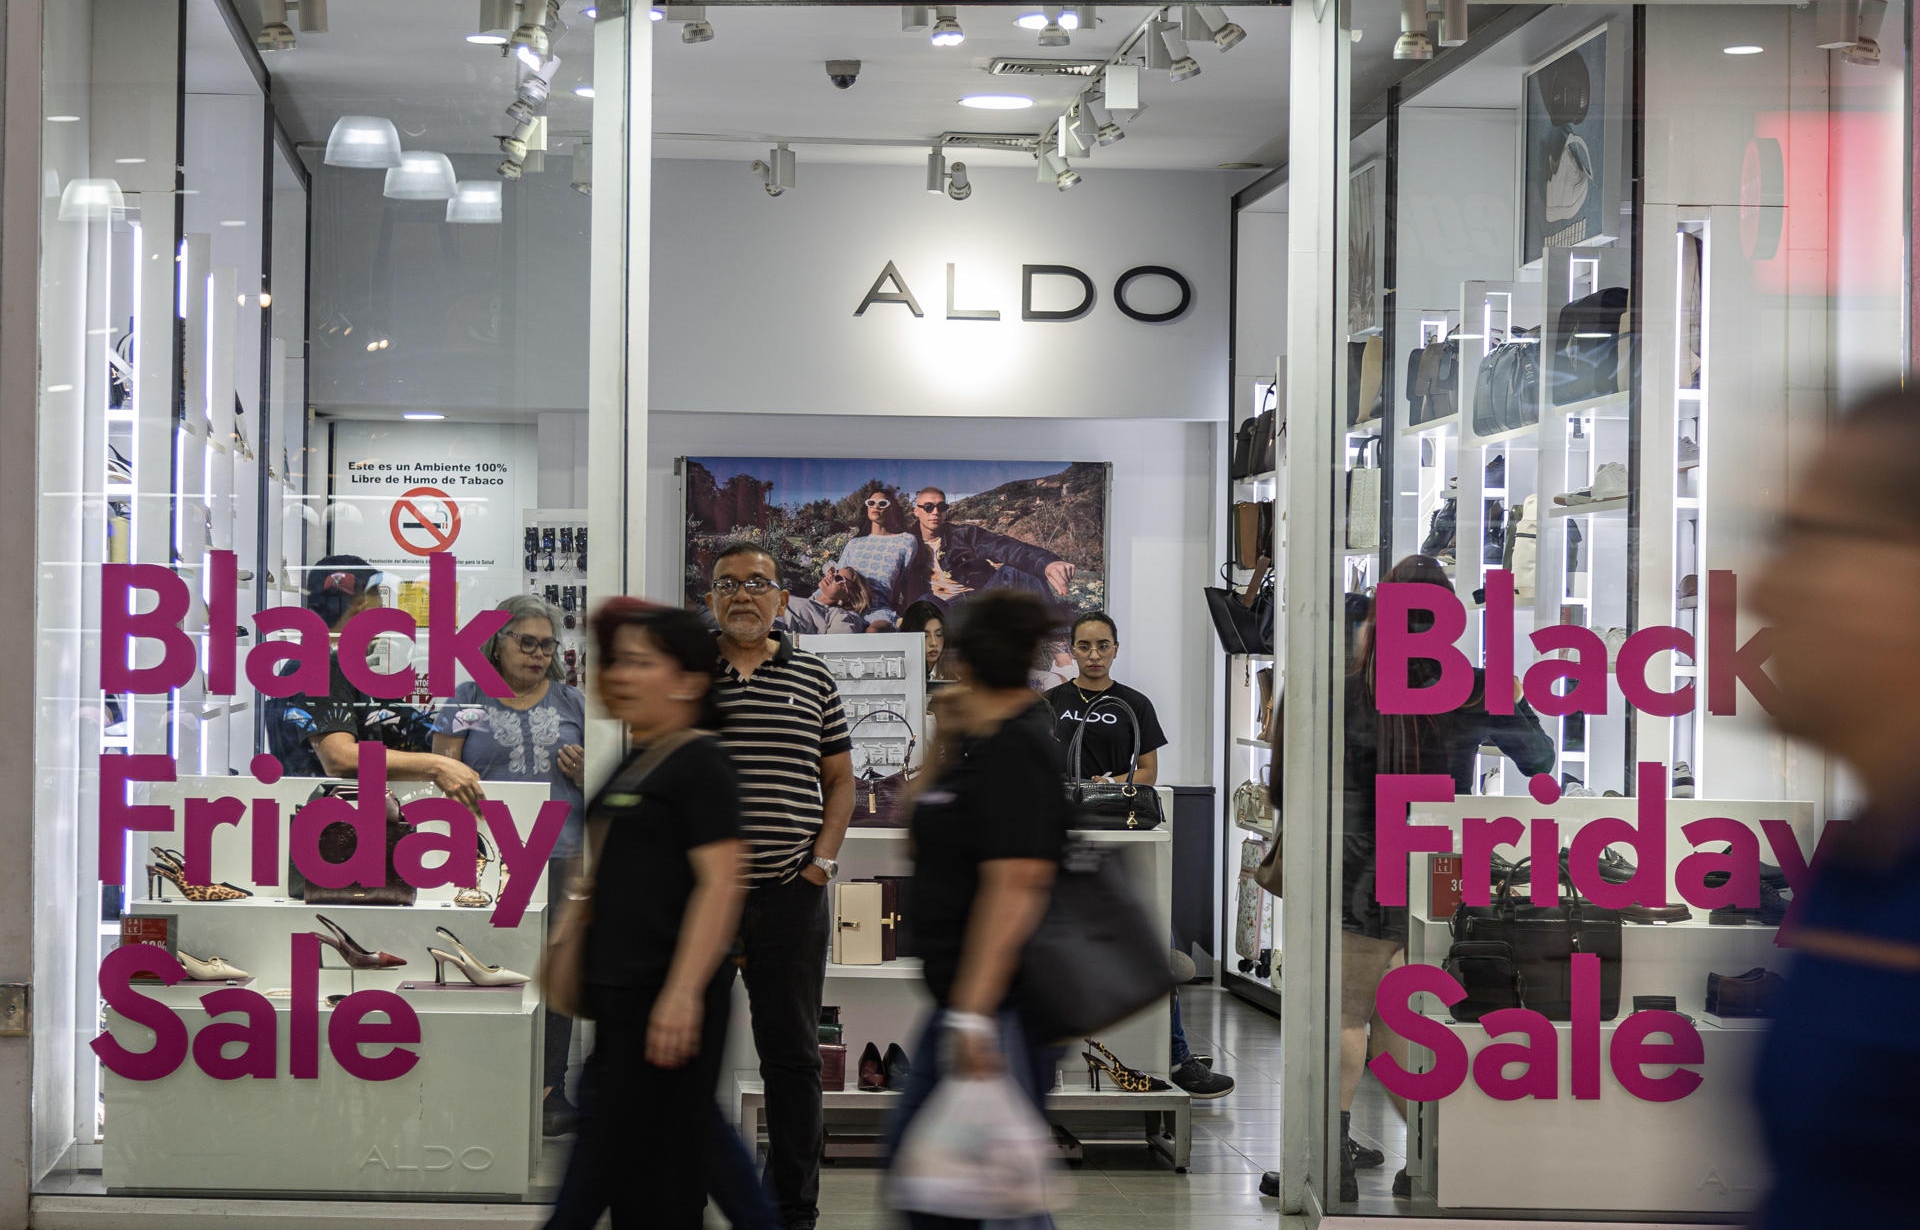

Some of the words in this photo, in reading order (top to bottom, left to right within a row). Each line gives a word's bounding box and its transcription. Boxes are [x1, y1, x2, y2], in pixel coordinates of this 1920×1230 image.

[852, 260, 1192, 323] ALDO
[348, 461, 375, 471] Este
[378, 463, 392, 471] es
[396, 463, 410, 471] un
[414, 462, 471, 472] Ambiente
[475, 463, 507, 473] 100%
[351, 475, 381, 484] Libre
[385, 475, 400, 484] de
[403, 475, 438, 485] Humo
[441, 475, 456, 485] de
[459, 475, 504, 486] Tabaco
[100, 550, 516, 699] Black
[1375, 570, 1778, 716] Black
[1060, 710, 1117, 724] ALDO
[99, 741, 572, 928] Friday
[1375, 762, 1850, 947] Friday
[90, 932, 421, 1081] Sale
[1368, 951, 1705, 1103] Sale
[359, 1144, 495, 1172] ALDO
